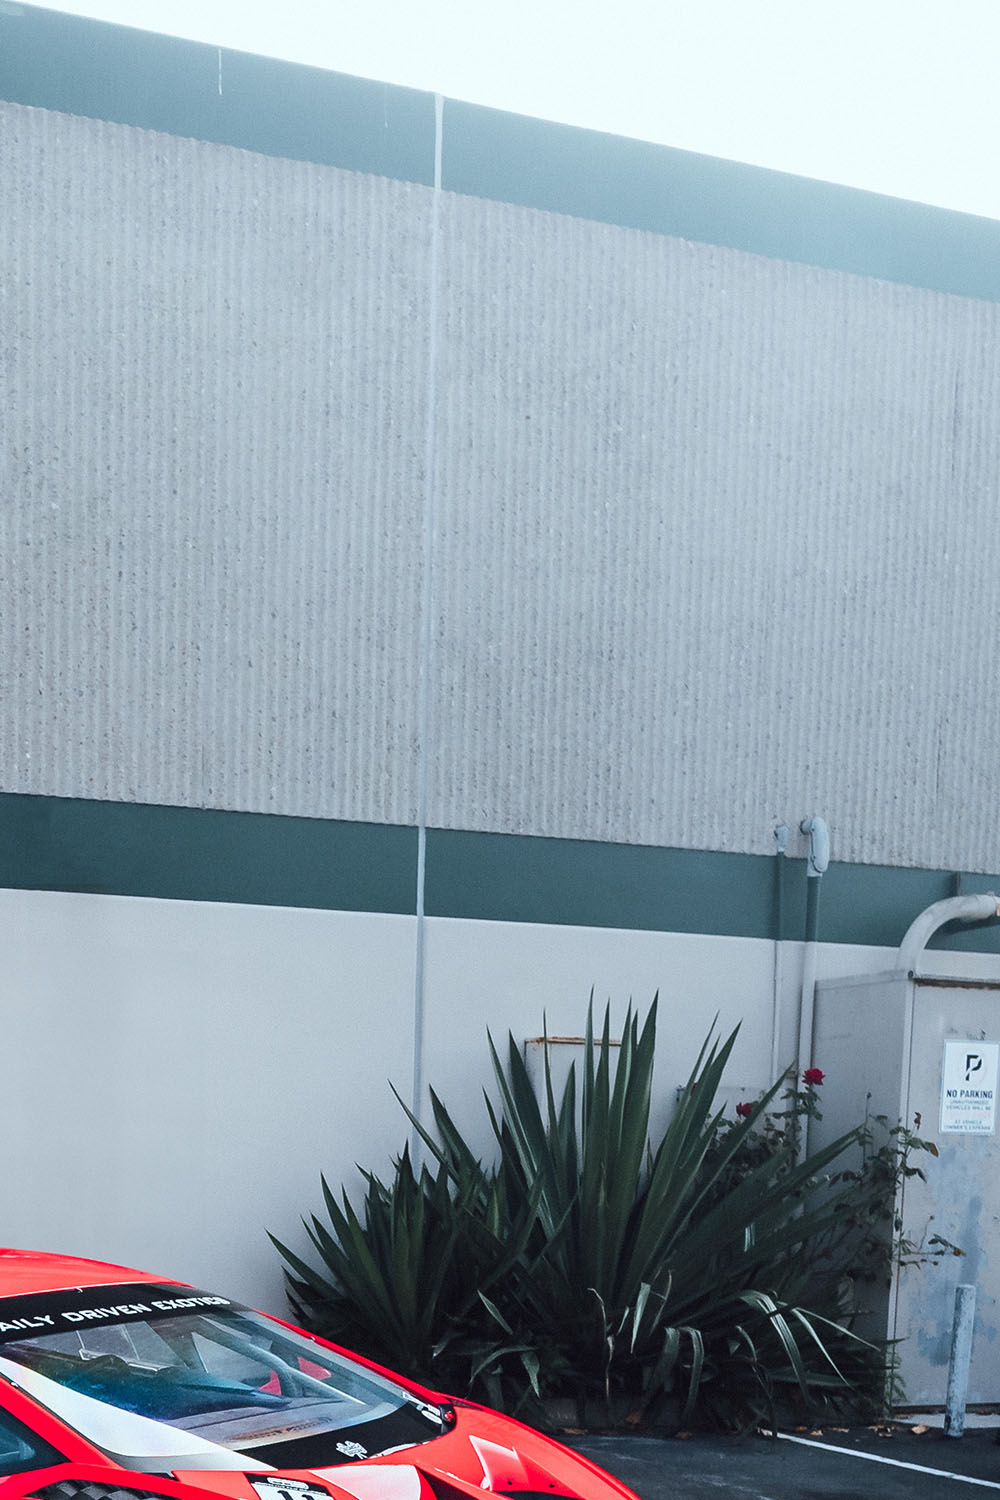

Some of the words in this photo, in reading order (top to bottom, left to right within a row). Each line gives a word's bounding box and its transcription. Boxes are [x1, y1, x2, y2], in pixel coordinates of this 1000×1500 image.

[946, 1089, 957, 1098] NO
[960, 1090, 993, 1099] PARKING
[61, 1303, 152, 1322] DRIVEN
[151, 1296, 231, 1311] EXOTICS
